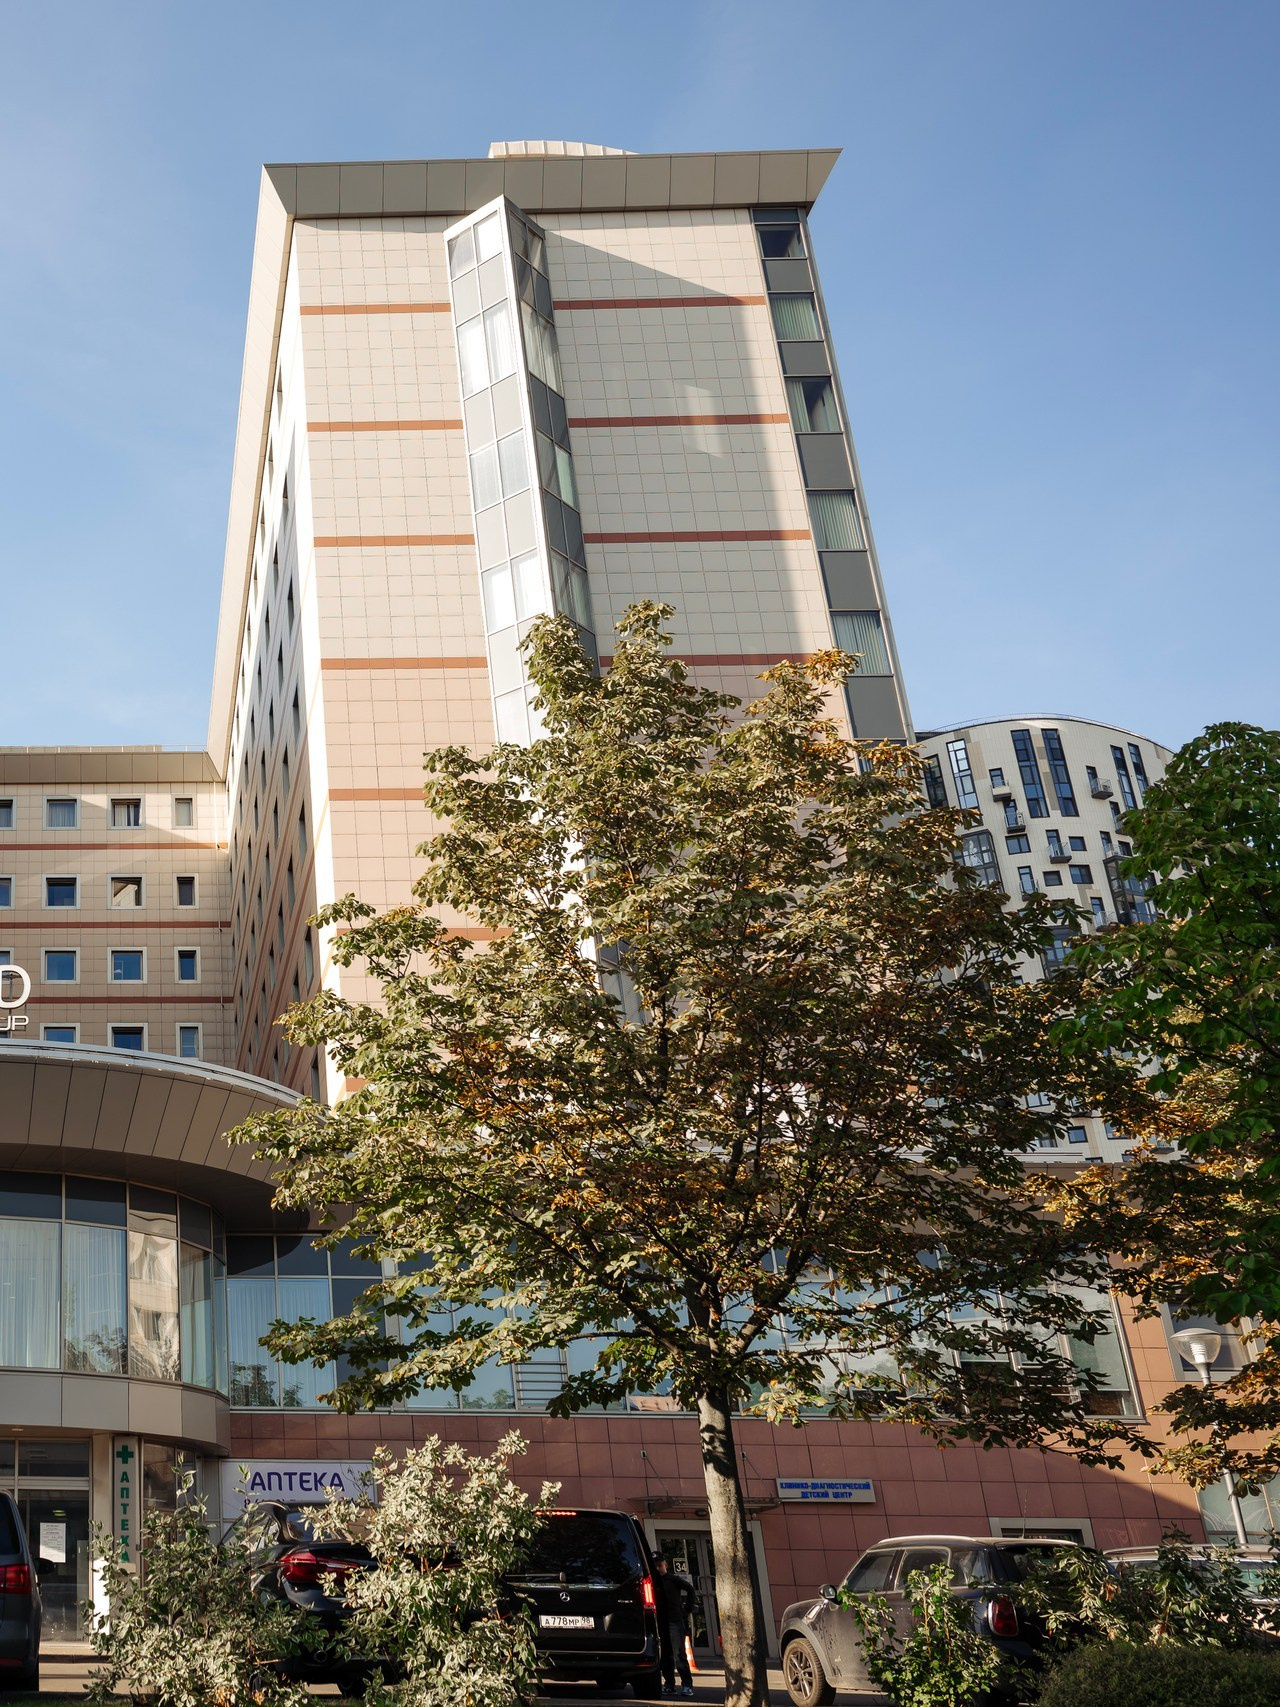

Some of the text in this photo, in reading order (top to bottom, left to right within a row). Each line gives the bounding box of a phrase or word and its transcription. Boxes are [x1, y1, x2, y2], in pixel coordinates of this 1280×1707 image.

[250, 1471, 345, 1492] АПТЕКА
[832, 1491, 853, 1499] ЦЕНТР
[120, 1471, 130, 1563] АПТЕКА
[675, 1562, 687, 1572] 34
